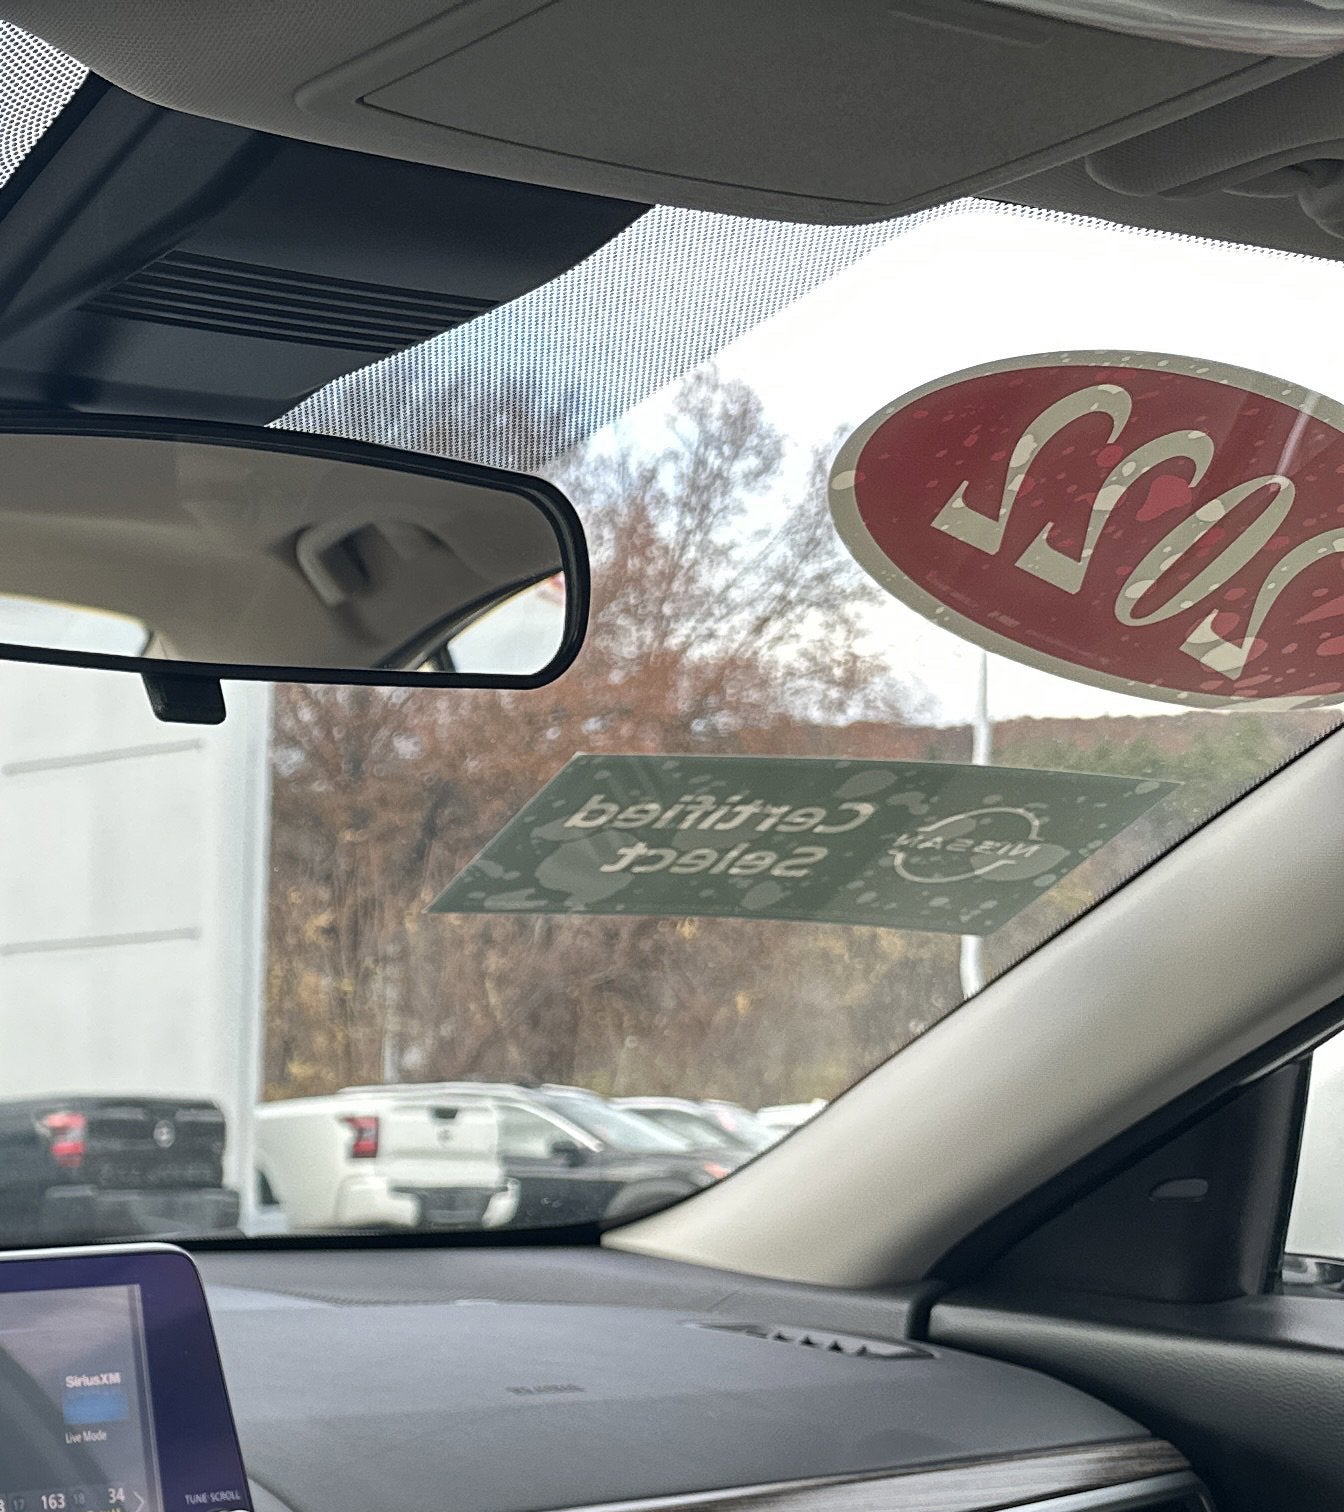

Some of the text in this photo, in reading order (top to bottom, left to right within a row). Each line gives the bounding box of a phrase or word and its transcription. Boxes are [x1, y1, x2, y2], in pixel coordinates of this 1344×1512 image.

[65, 1430, 107, 1444] Live Mode
[41, 1493, 65, 1510] 163
[107, 1487, 125, 1504] 34
